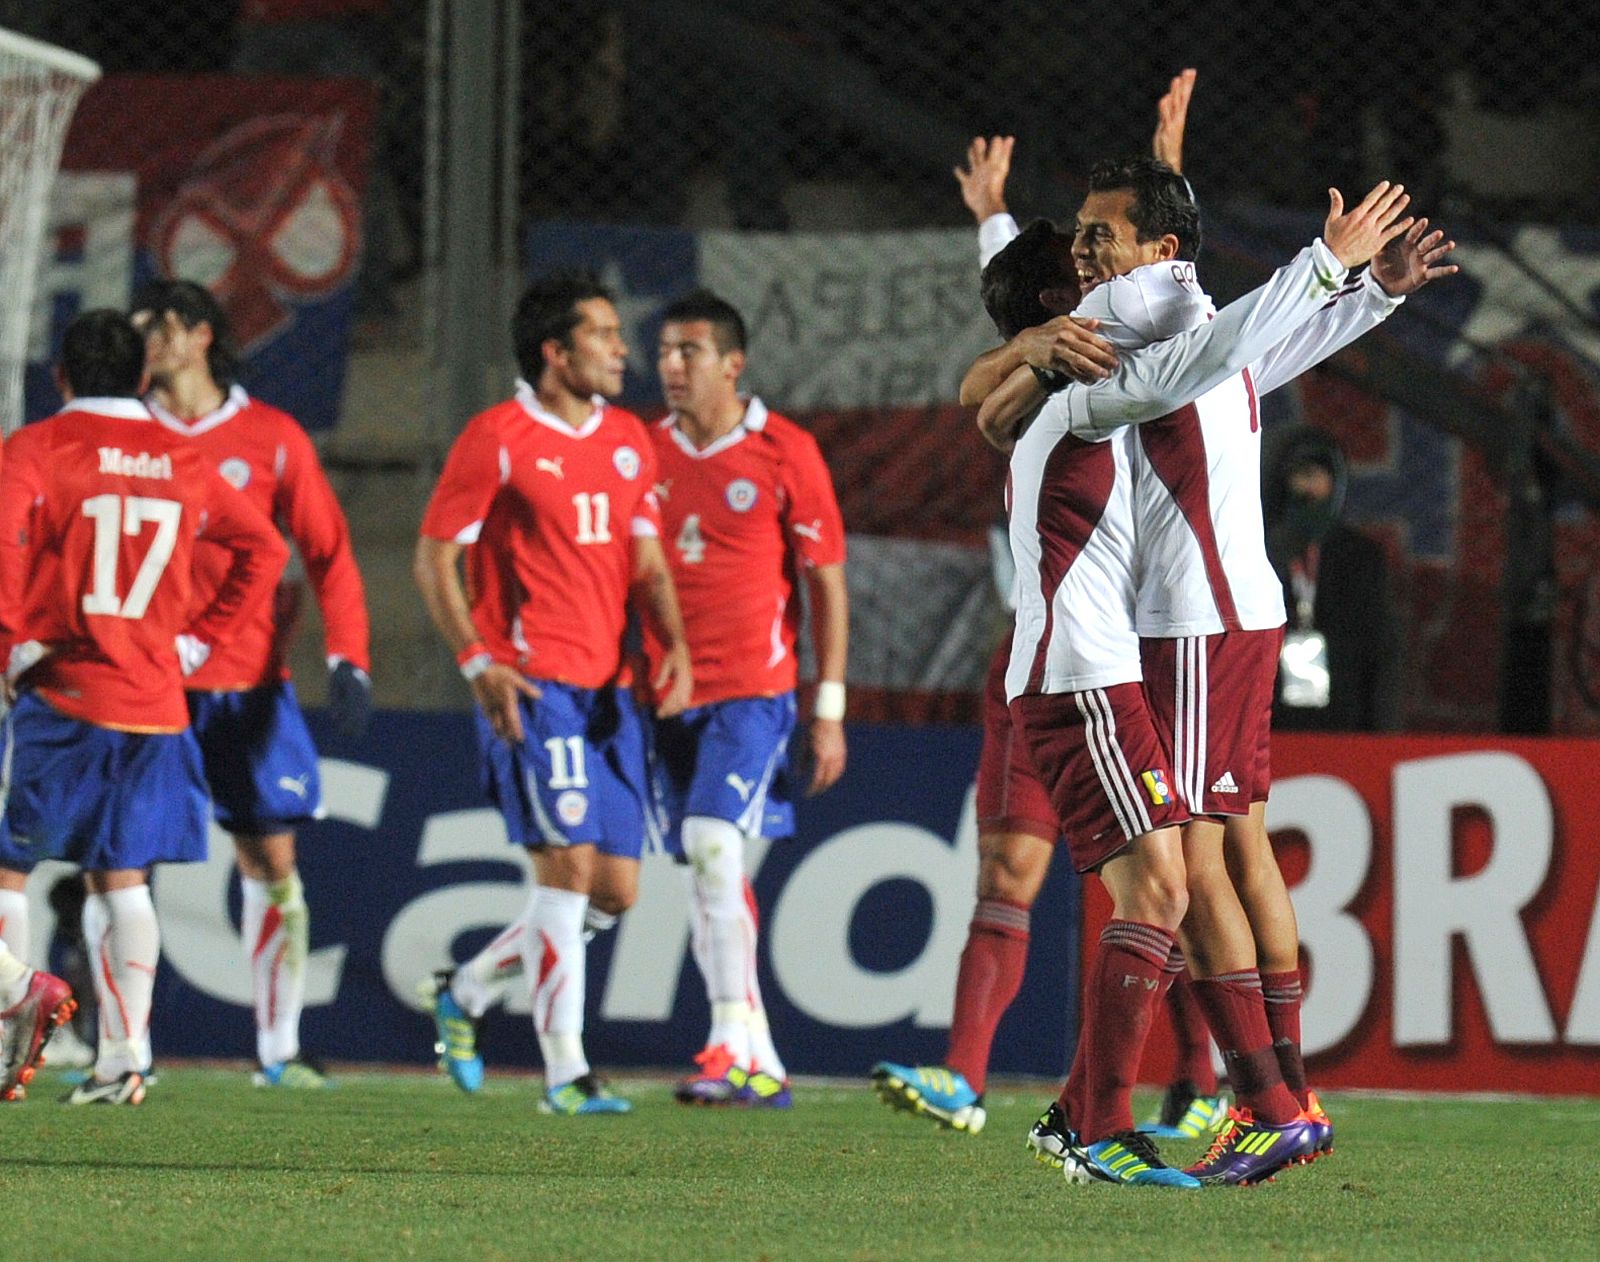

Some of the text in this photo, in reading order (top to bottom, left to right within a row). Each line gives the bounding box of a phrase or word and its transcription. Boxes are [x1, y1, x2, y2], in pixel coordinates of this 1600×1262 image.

[572, 492, 612, 544] 11
[677, 514, 706, 564] 4
[82, 494, 182, 619] 17
[544, 735, 589, 789] 11
[1209, 750, 1600, 1078] BR
